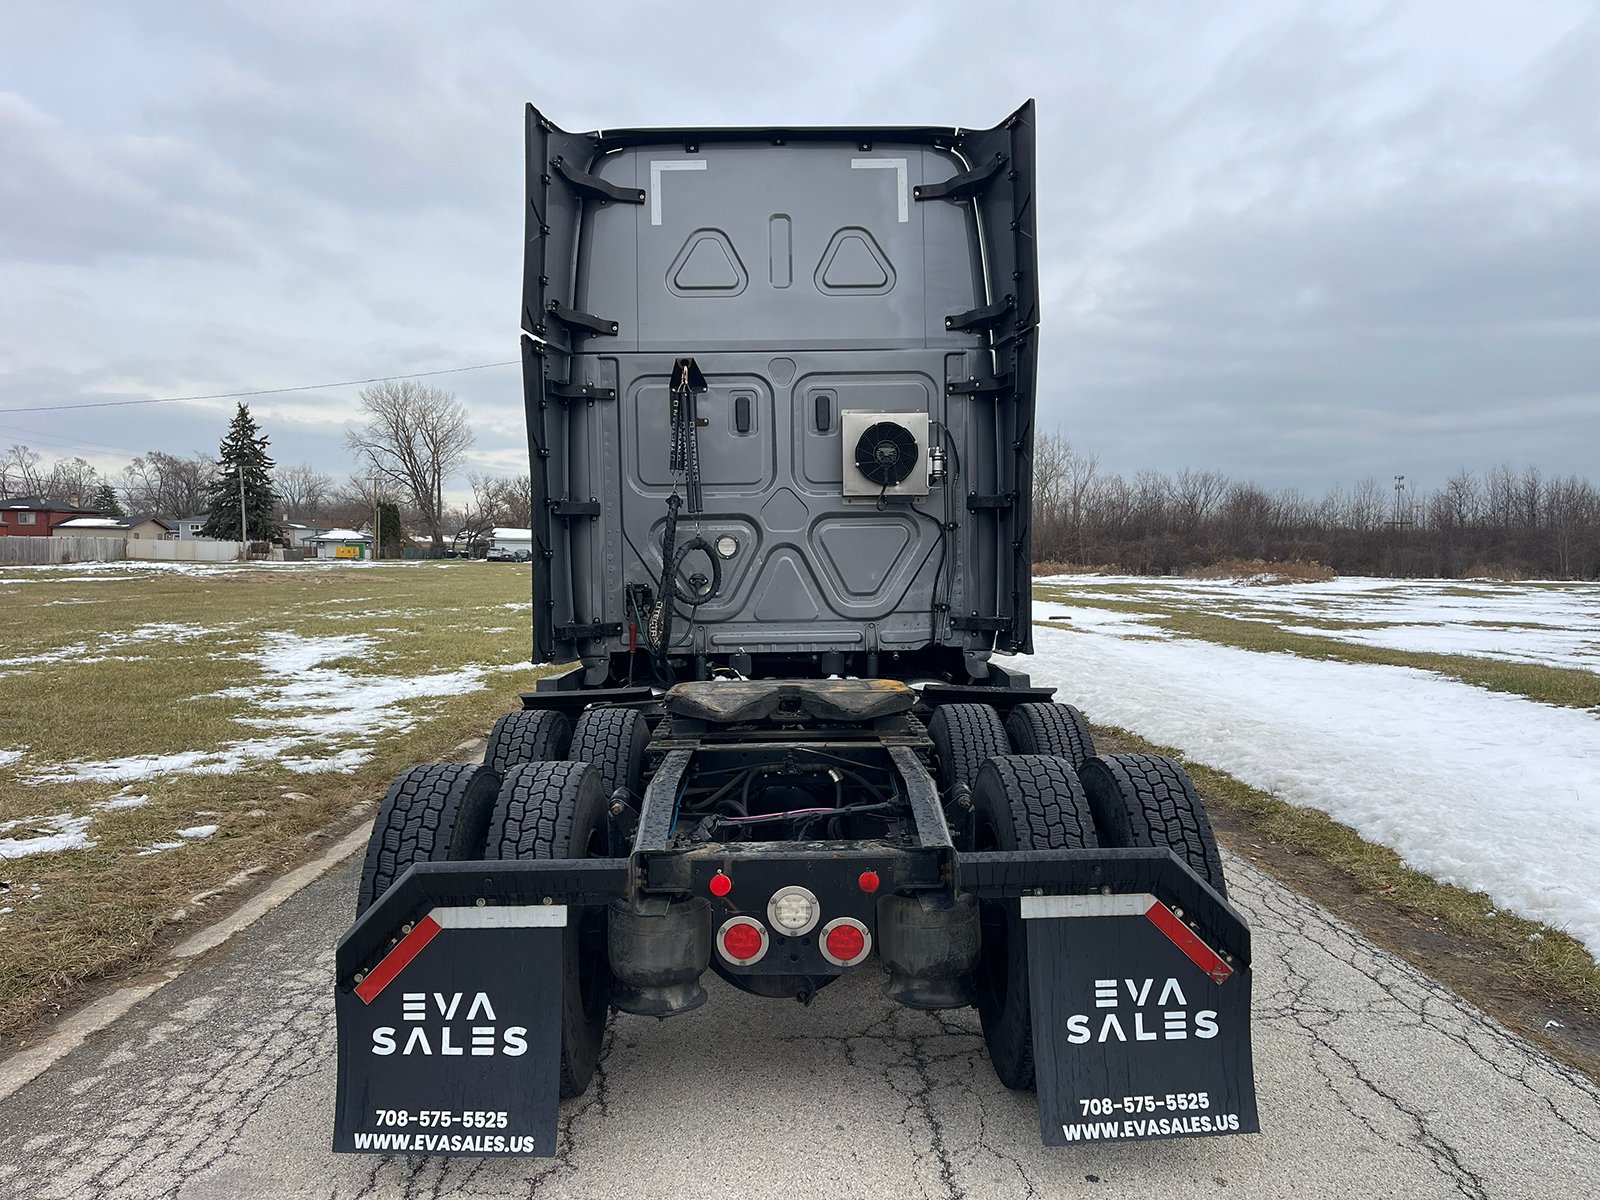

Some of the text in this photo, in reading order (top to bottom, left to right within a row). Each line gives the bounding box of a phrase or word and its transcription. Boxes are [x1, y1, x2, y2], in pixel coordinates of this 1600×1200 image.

[403, 992, 496, 1021] EVA
[1095, 978, 1187, 1008] EVA
[371, 1026, 528, 1056] SALES
[1066, 1010, 1219, 1044] SALES
[1079, 1092, 1210, 1116] 708-575-5525
[375, 1110, 508, 1128] 708-575-5525
[1062, 1114, 1240, 1141] WWW.EVASALES.US
[354, 1133, 534, 1153] WWW.EVASALES.US
